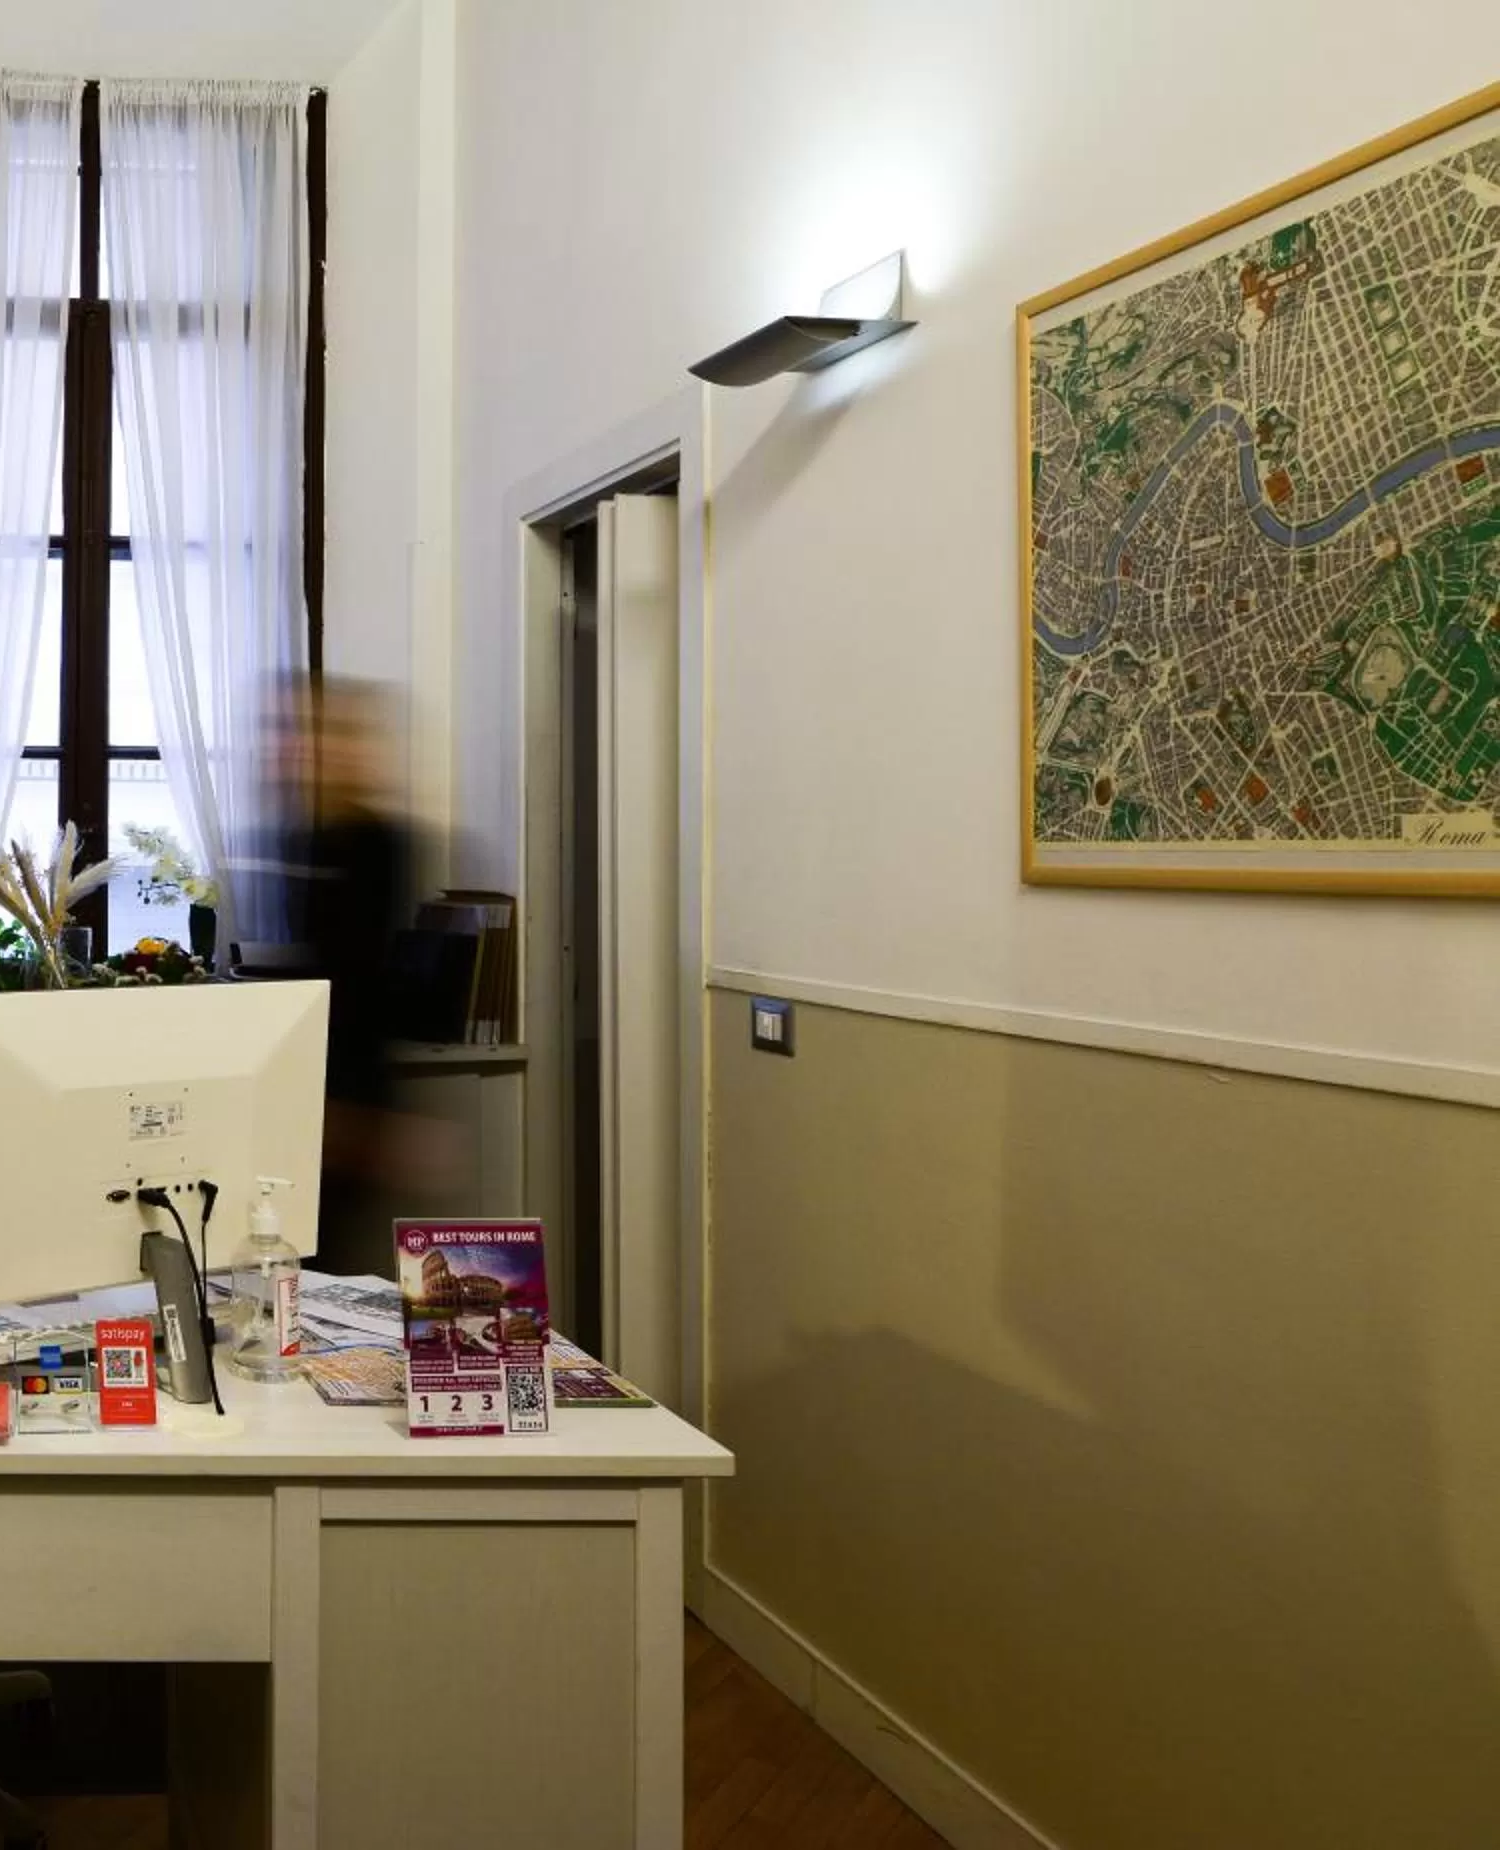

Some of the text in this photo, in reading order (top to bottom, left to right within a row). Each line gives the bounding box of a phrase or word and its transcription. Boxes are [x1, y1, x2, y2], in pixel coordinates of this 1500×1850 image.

[1409, 817, 1487, 845] Roma
[432, 1231, 536, 1243] BEST TOURS IN ROME
[101, 1328, 145, 1341] satispay
[59, 1380, 79, 1389] VISA
[420, 1393, 493, 1412] 1 2 3
